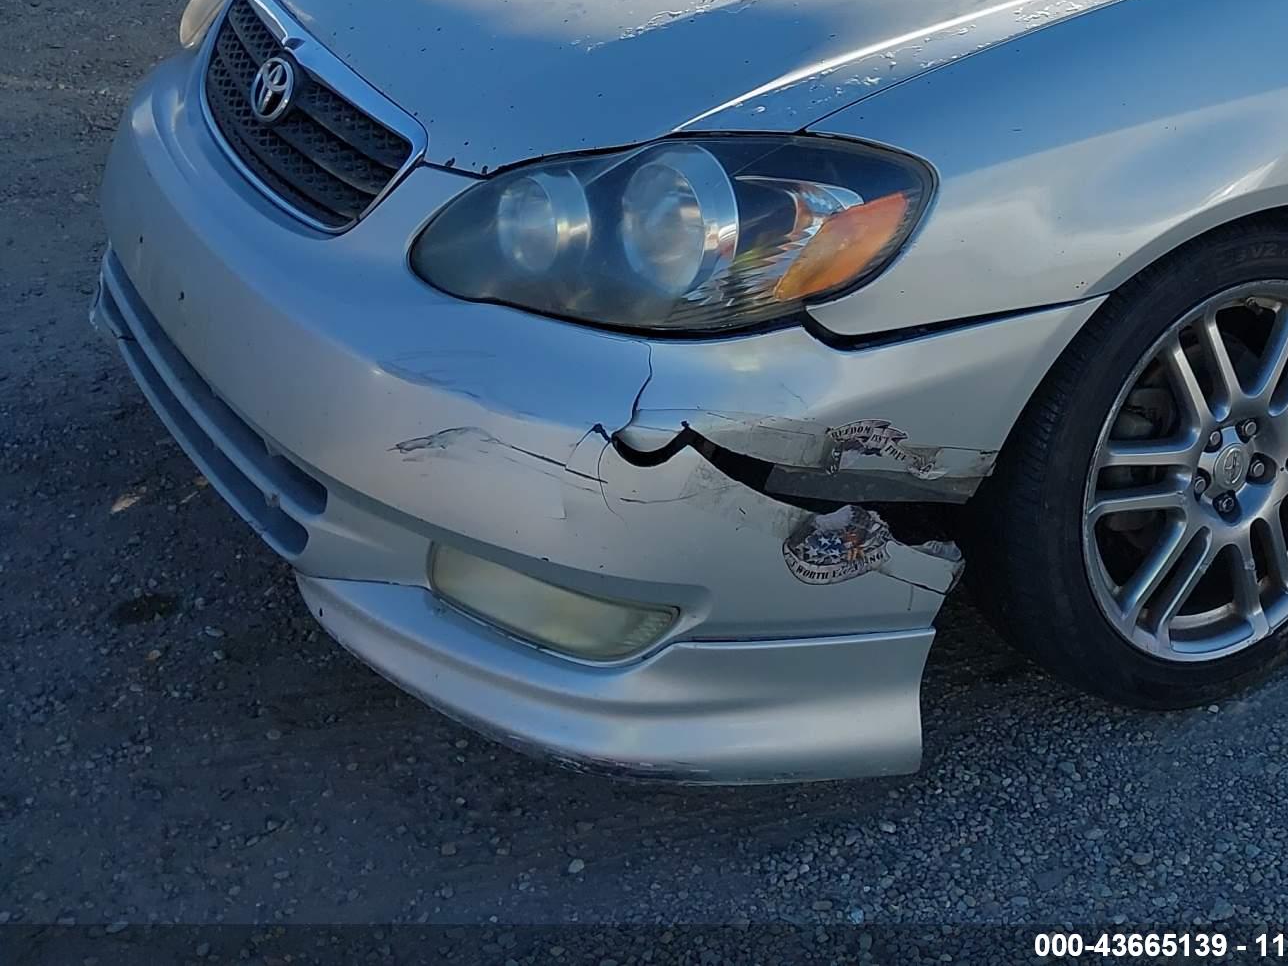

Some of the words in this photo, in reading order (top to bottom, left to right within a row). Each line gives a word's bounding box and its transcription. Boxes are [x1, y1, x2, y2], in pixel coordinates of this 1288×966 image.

[831, 425, 871, 438] REEDOM
[884, 444, 907, 462] FREE
[796, 564, 829, 580] WORTH
